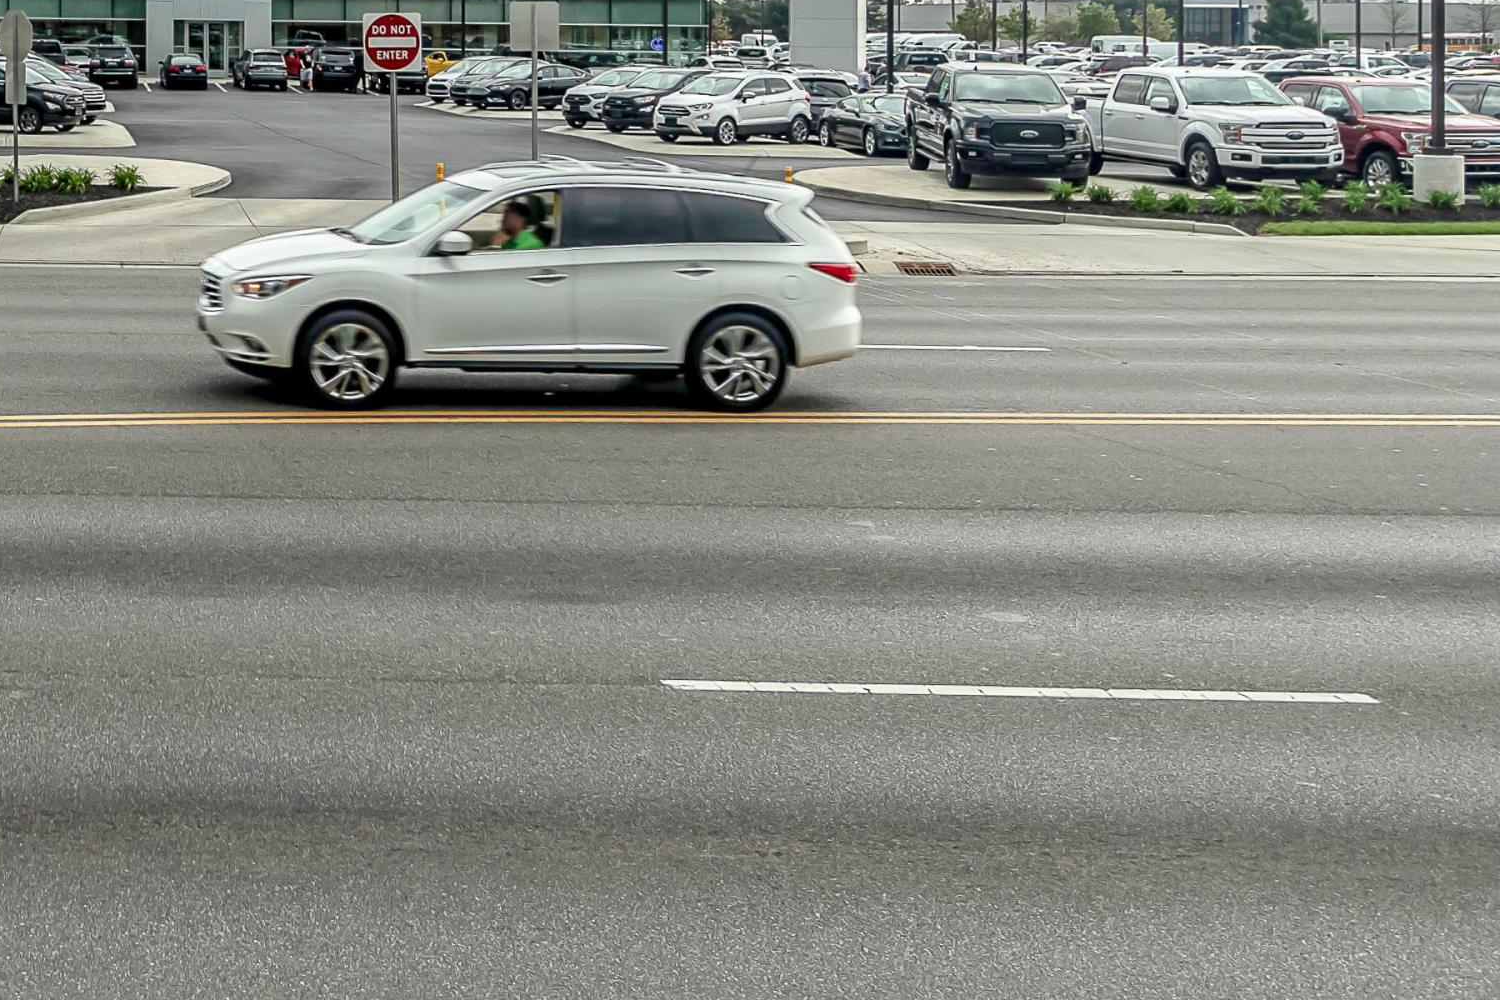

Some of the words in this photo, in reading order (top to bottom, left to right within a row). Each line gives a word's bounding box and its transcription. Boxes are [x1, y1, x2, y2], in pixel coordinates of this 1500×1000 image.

[371, 25, 387, 35] DO
[390, 25, 412, 35] NOT
[376, 50, 409, 60] ENTER
